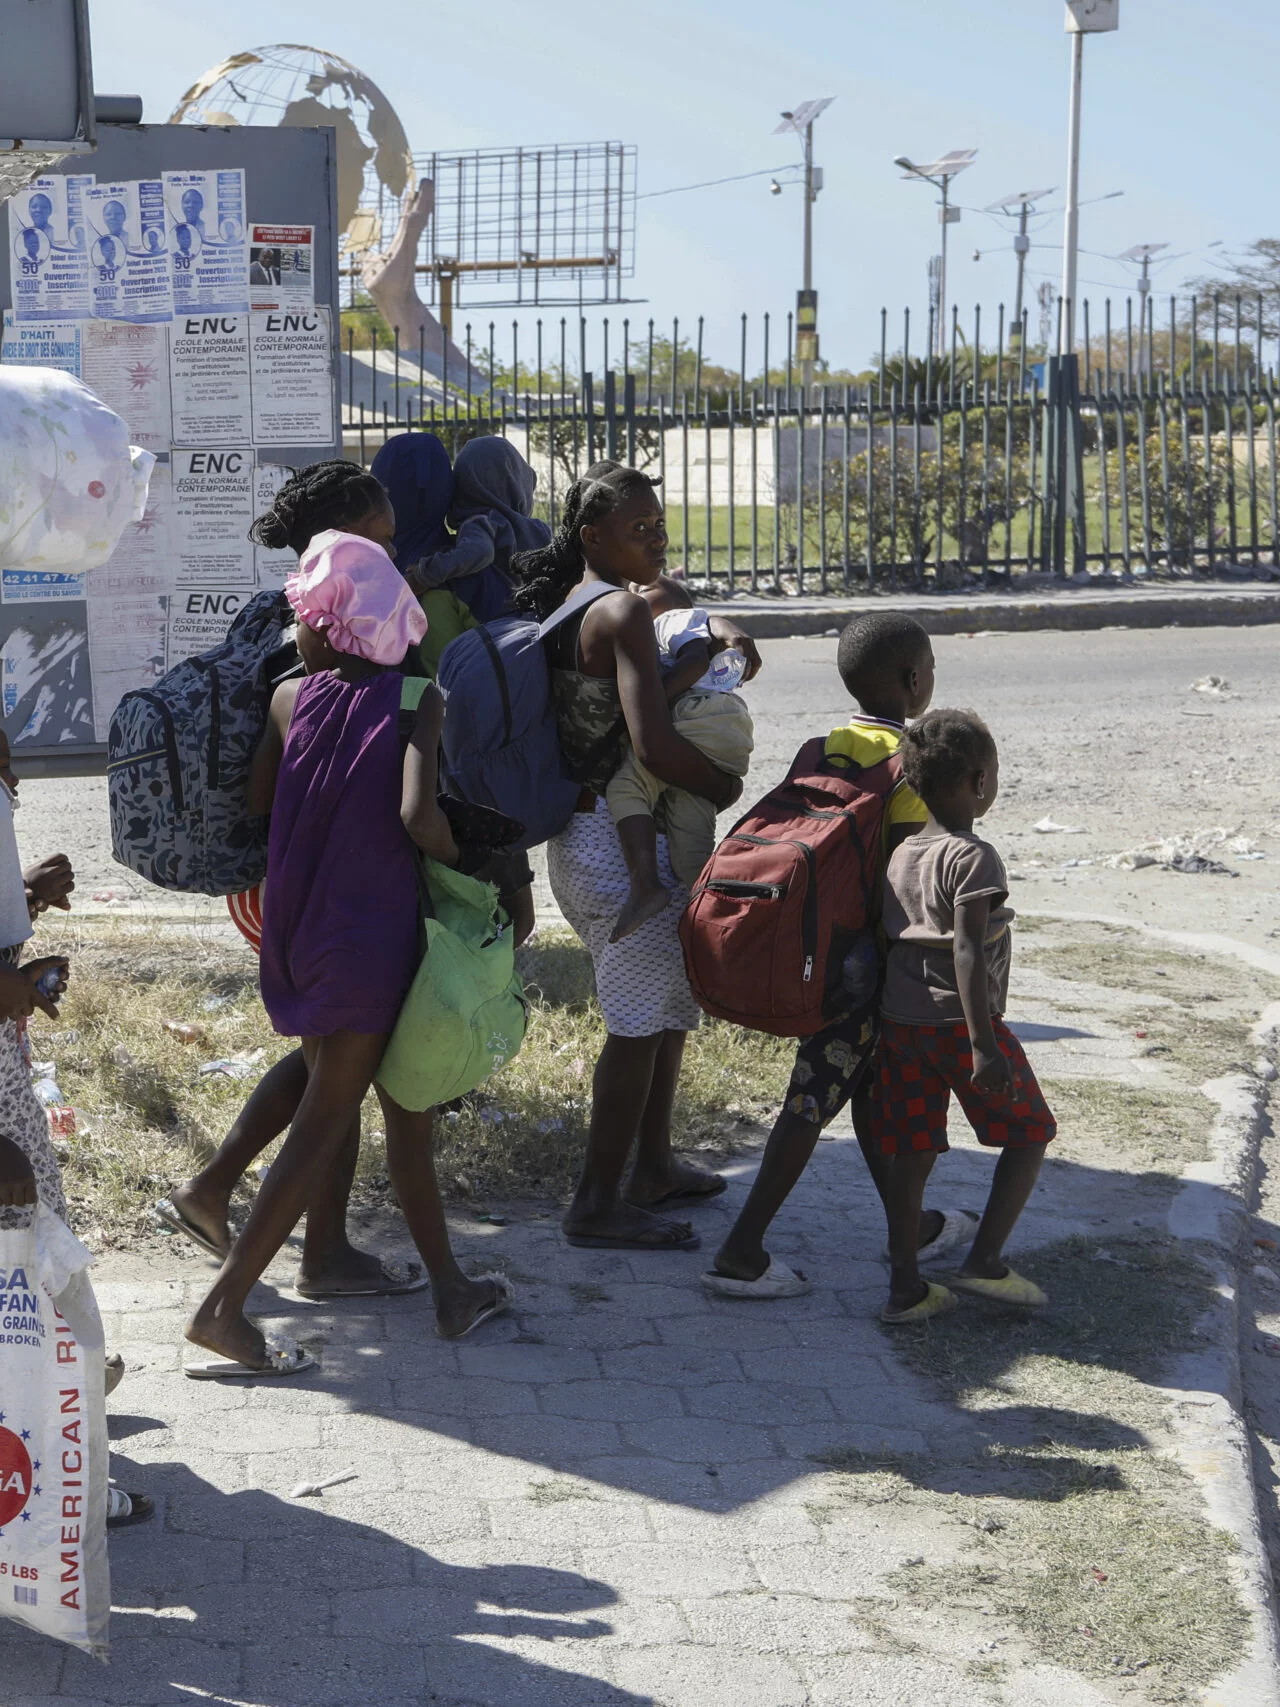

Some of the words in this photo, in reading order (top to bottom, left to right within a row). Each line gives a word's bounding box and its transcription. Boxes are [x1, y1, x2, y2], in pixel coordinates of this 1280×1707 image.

[22, 262, 38, 274] 50
[175, 257, 190, 269] 50
[100, 269, 115, 281] 50
[195, 267, 232, 275] Ouverture
[121, 278, 156, 286] Ouverture
[124, 285, 167, 295] Inscriptions
[21, 331, 55, 339] D'HAITI
[285, 335, 325, 343] NORMALE
[175, 338, 202, 346] ECOLE
[204, 337, 244, 345] NORMALE
[173, 345, 247, 355] CONTEMPORAINE
[254, 343, 327, 351] CONTEMPORAINE
[189, 453, 242, 473] ENC
[4, 575, 19, 583] 42
[23, 574, 38, 583] 41
[42, 573, 58, 582] 47
[63, 573, 79, 582] 74
[186, 594, 240, 615] ENC
[173, 625, 227, 633] CONTEMPOR
[59, 1388, 82, 1611] AMERICAN
[12, 1564, 39, 1580] LBS
